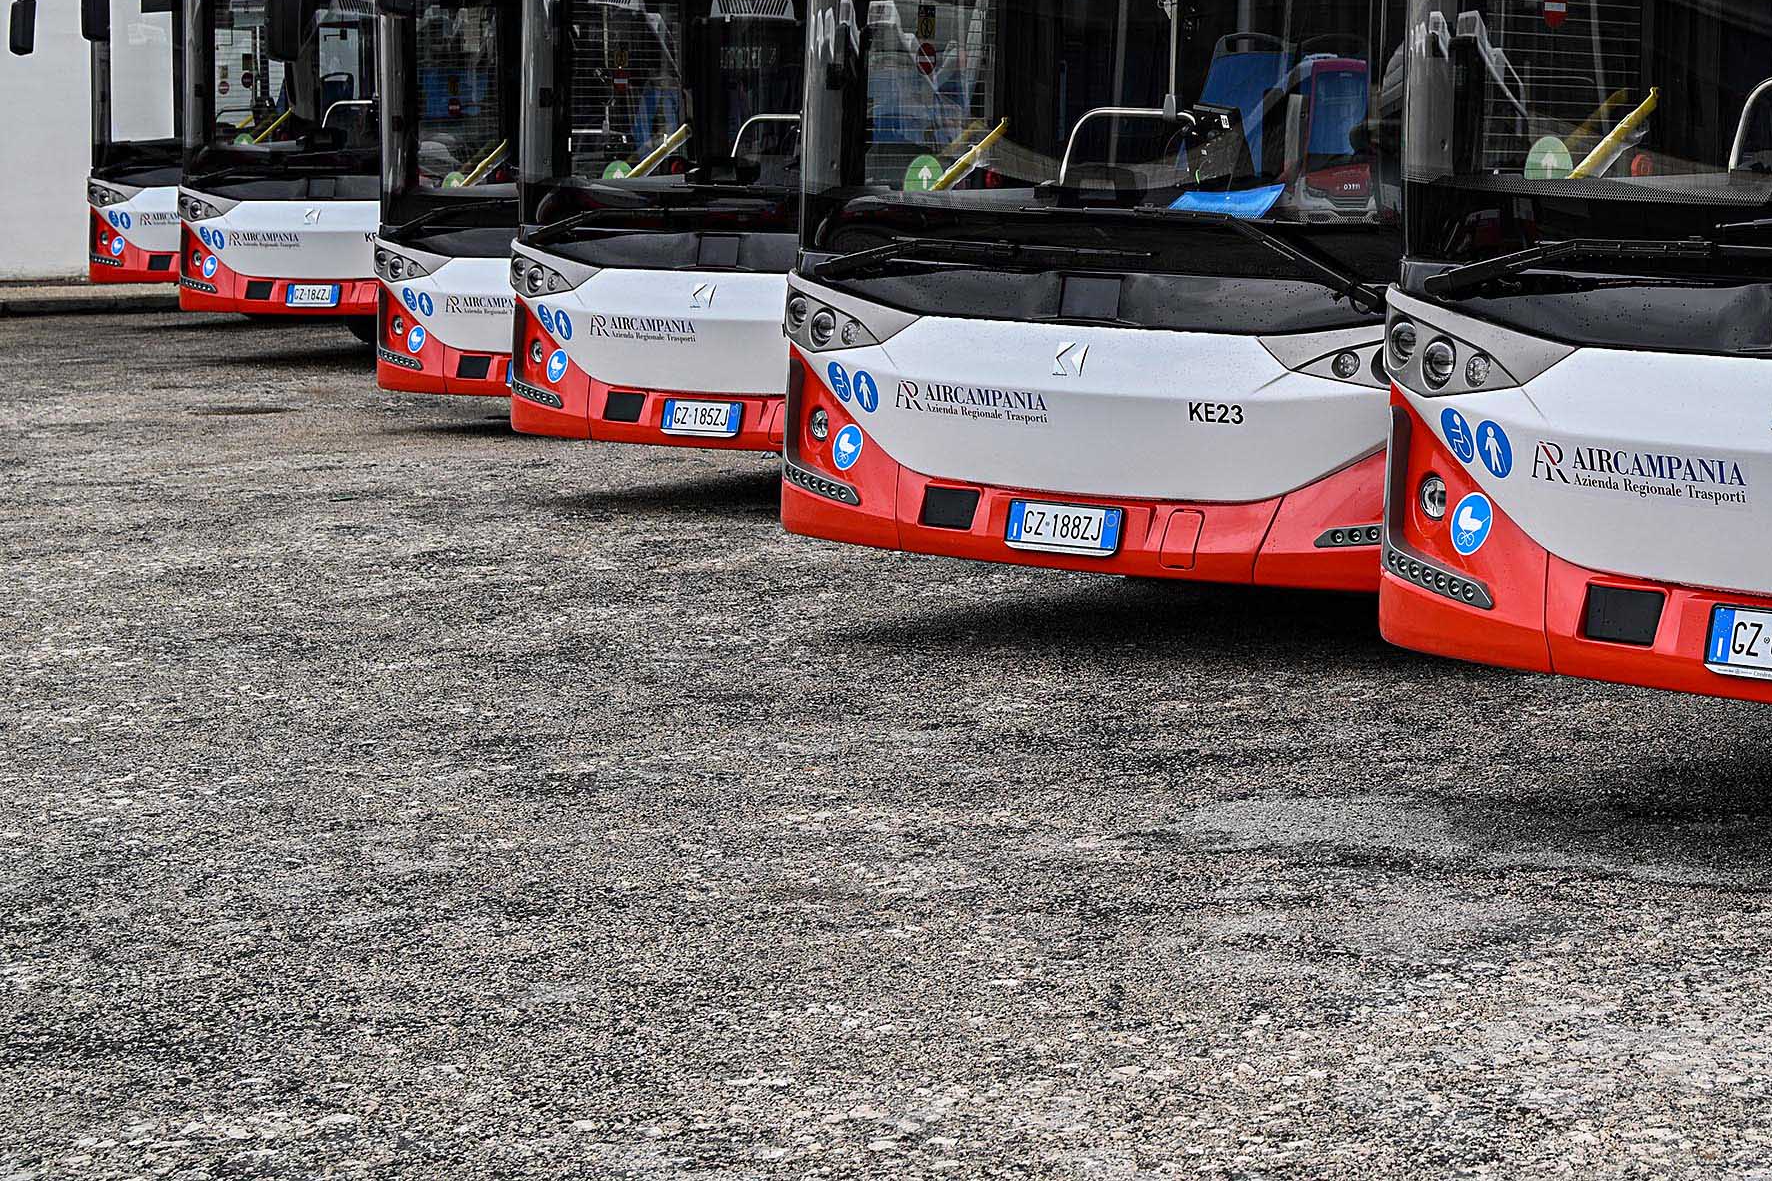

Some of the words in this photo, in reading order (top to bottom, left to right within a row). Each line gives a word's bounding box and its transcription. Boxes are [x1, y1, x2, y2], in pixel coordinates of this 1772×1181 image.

[610, 316, 696, 334] AIRCAMPANIA
[924, 383, 1048, 412] AIRCAMPANIA
[925, 402, 959, 416] Azienda
[960, 405, 1003, 421] Regionale
[1004, 410, 1048, 425] Trasporti
[1188, 401, 1244, 425] KE23
[1571, 446, 1748, 487] AIRCAMPANIA
[1573, 472, 1620, 491] Azienda
[1623, 476, 1683, 498] Regionale
[1685, 484, 1747, 506] Trasporti
